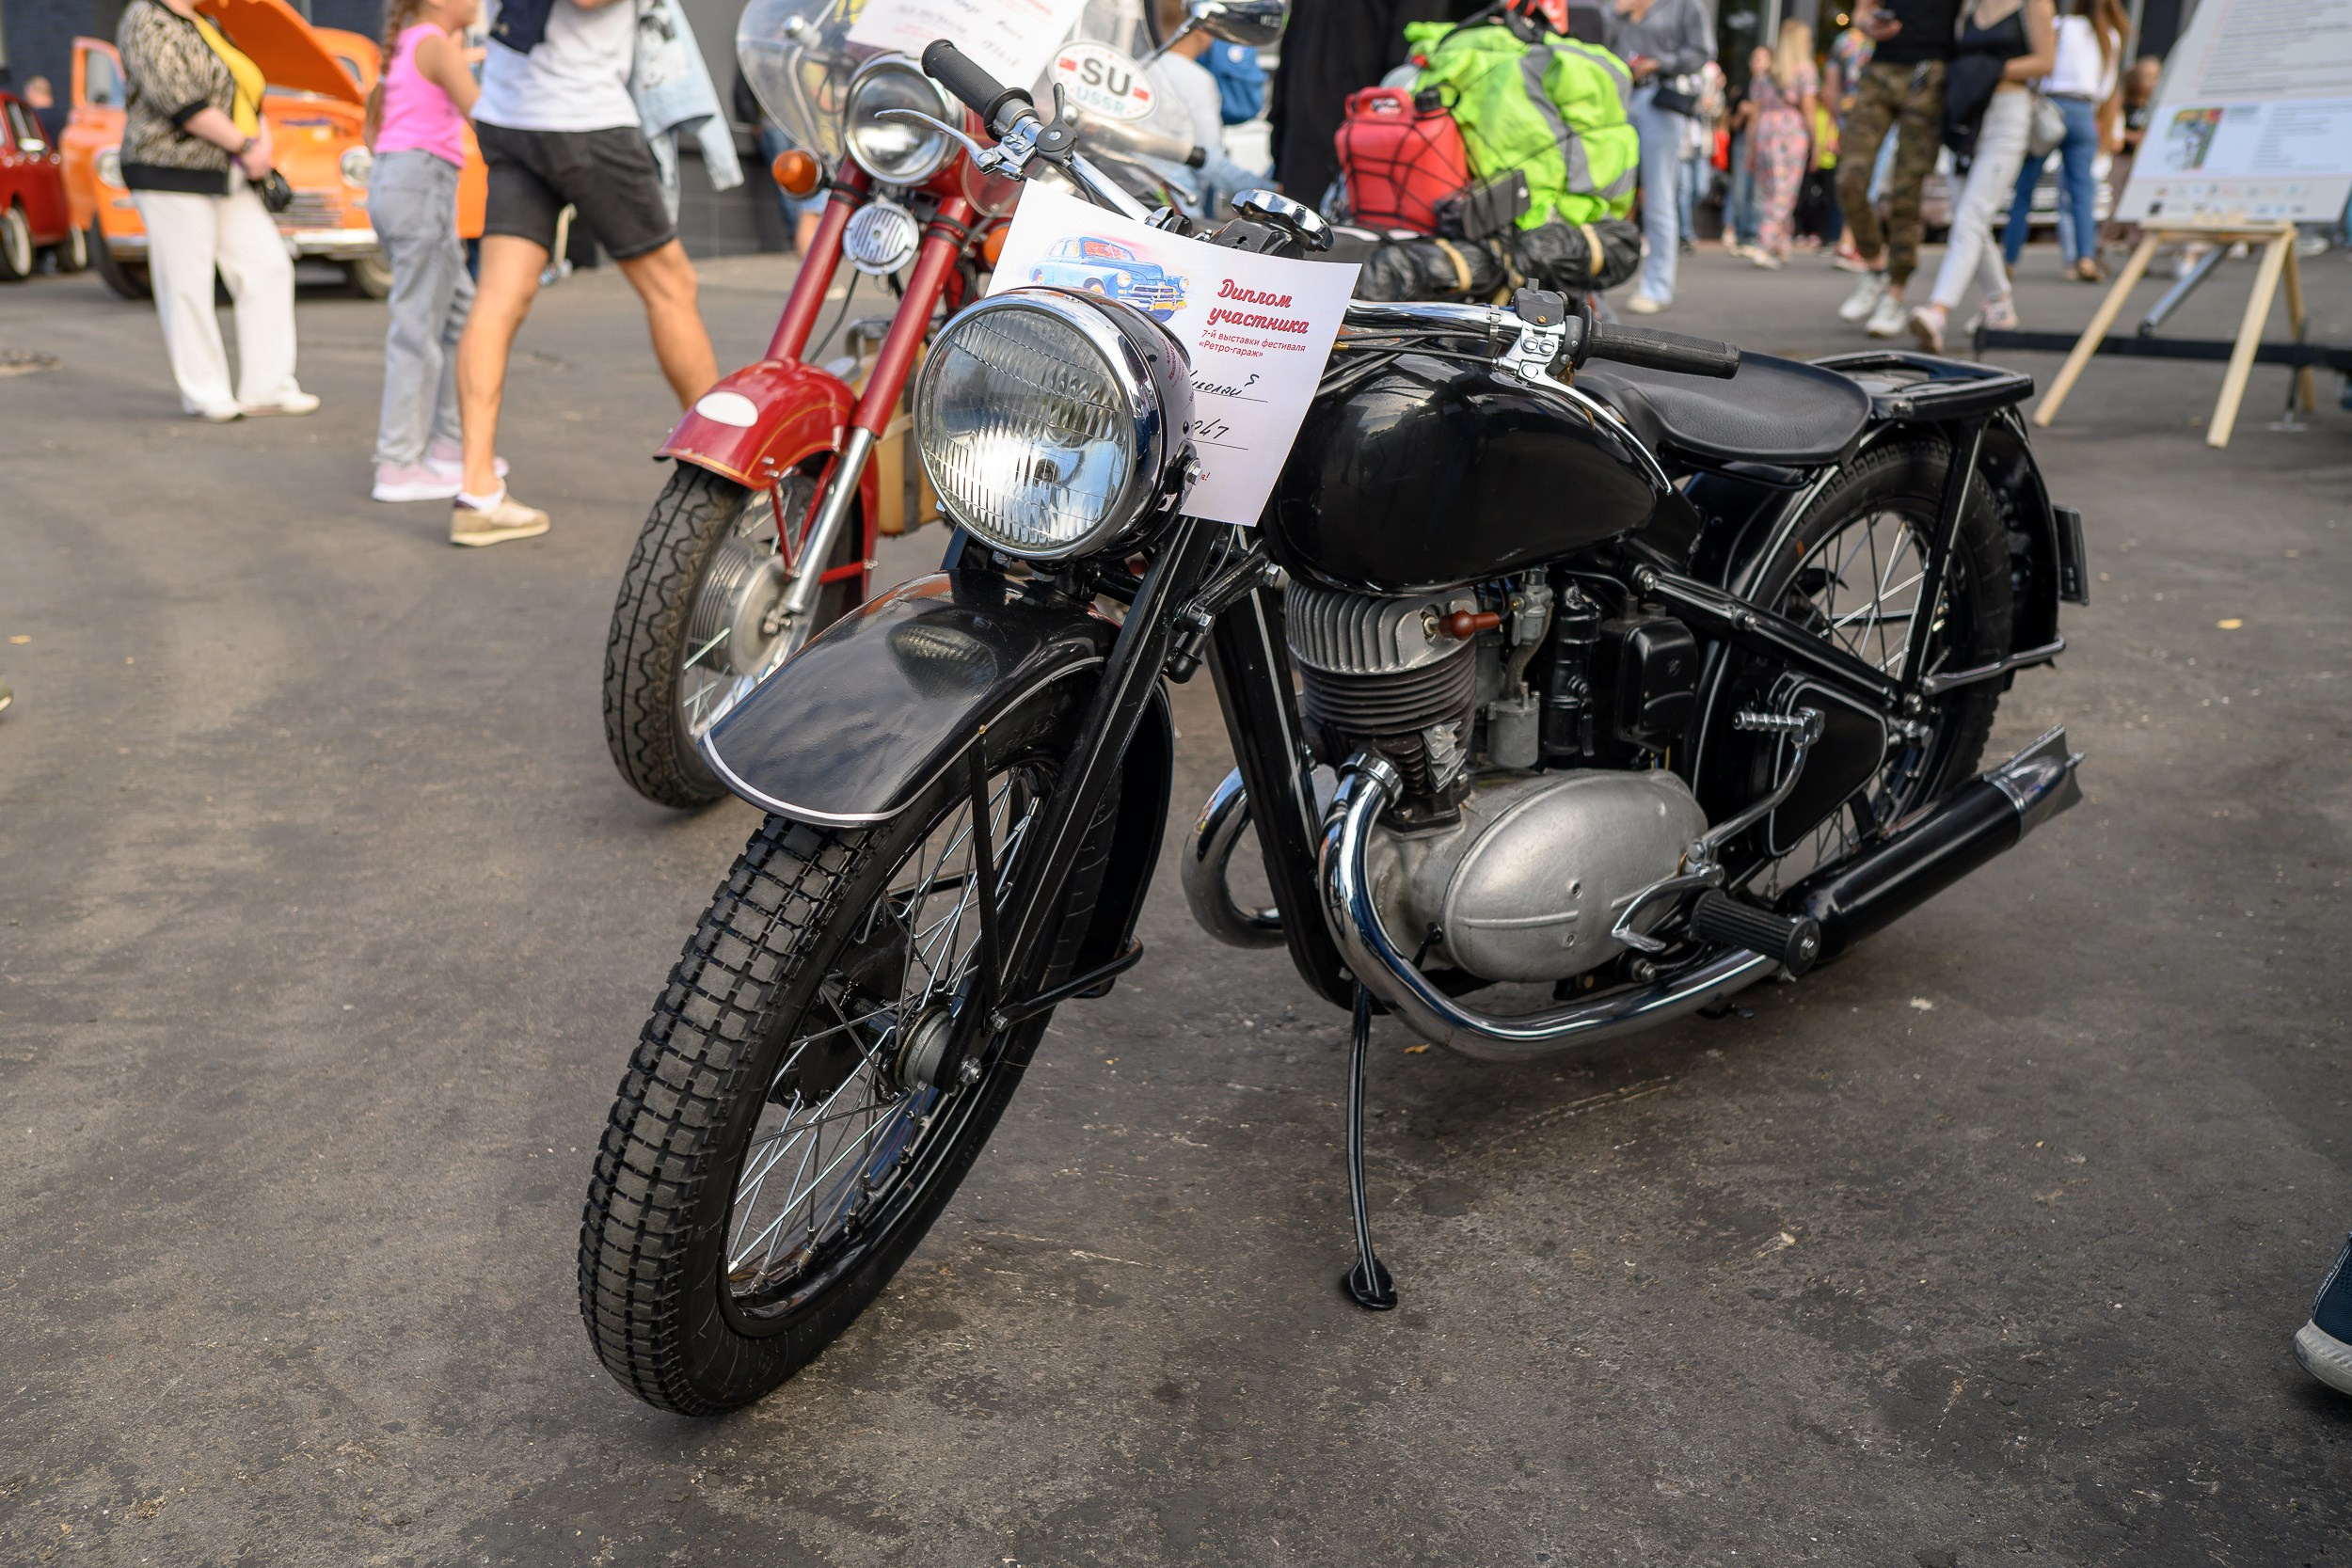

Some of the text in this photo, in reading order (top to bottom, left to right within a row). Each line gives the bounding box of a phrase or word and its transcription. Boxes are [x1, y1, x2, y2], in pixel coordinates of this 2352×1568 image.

[1080, 57, 1131, 97] SU
[1075, 86, 1125, 113] USSR
[1217, 278, 1293, 309] Диплом
[1207, 307, 1310, 334] участника
[1199, 341, 1263, 357] «Ретро-гараж»
[1201, 329, 1306, 352] 7-й выставки фестиваля
